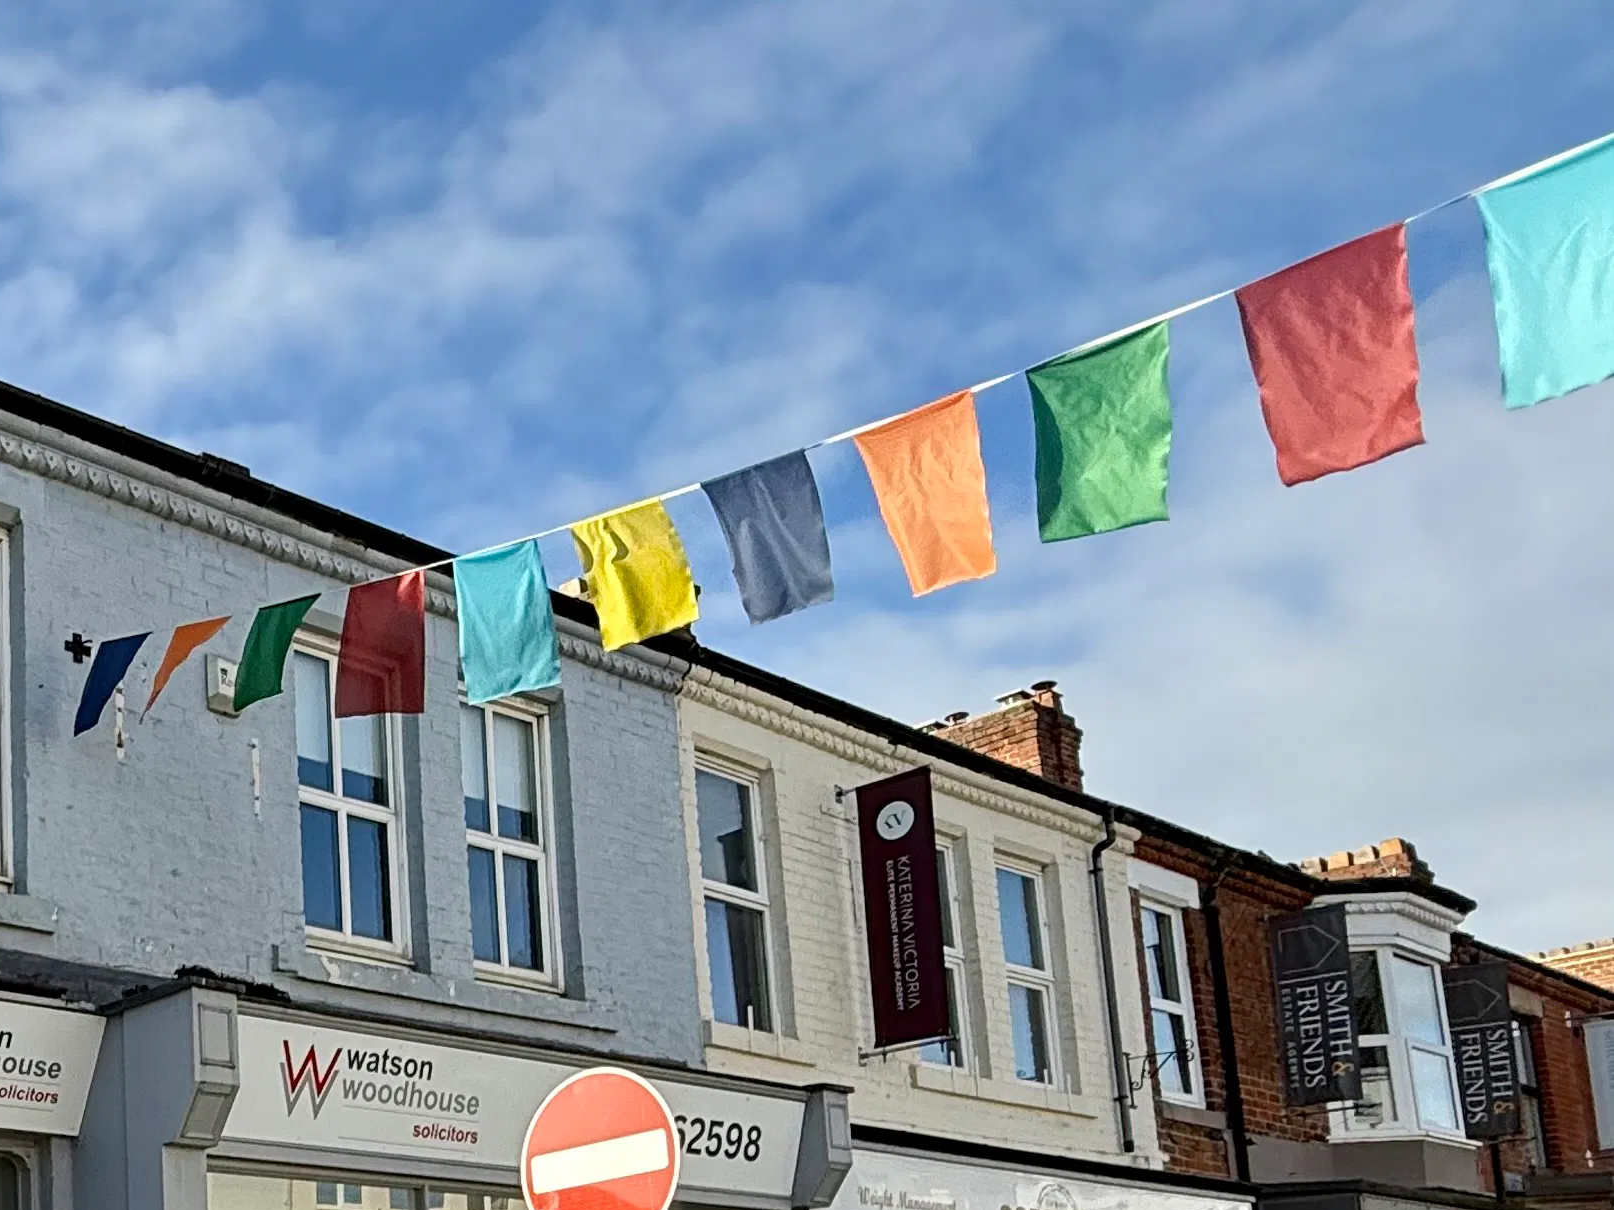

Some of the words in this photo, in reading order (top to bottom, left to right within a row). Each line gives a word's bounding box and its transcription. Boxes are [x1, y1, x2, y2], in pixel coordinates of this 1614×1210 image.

[897, 855, 916, 932] KATERINA
[903, 933, 922, 1010] VICTORIA
[1281, 988, 1295, 1033] ESTATE
[1296, 985, 1327, 1088] FRIENDS
[1324, 980, 1353, 1057] SMITH
[347, 1048, 433, 1080] watson
[1331, 1061, 1355, 1077] &
[1459, 1032, 1488, 1124] FRIENDS
[1486, 1028, 1513, 1097] SMITH
[342, 1078, 479, 1115] woodhouse
[1493, 1101, 1514, 1114] &
[413, 1123, 478, 1144] solicitors
